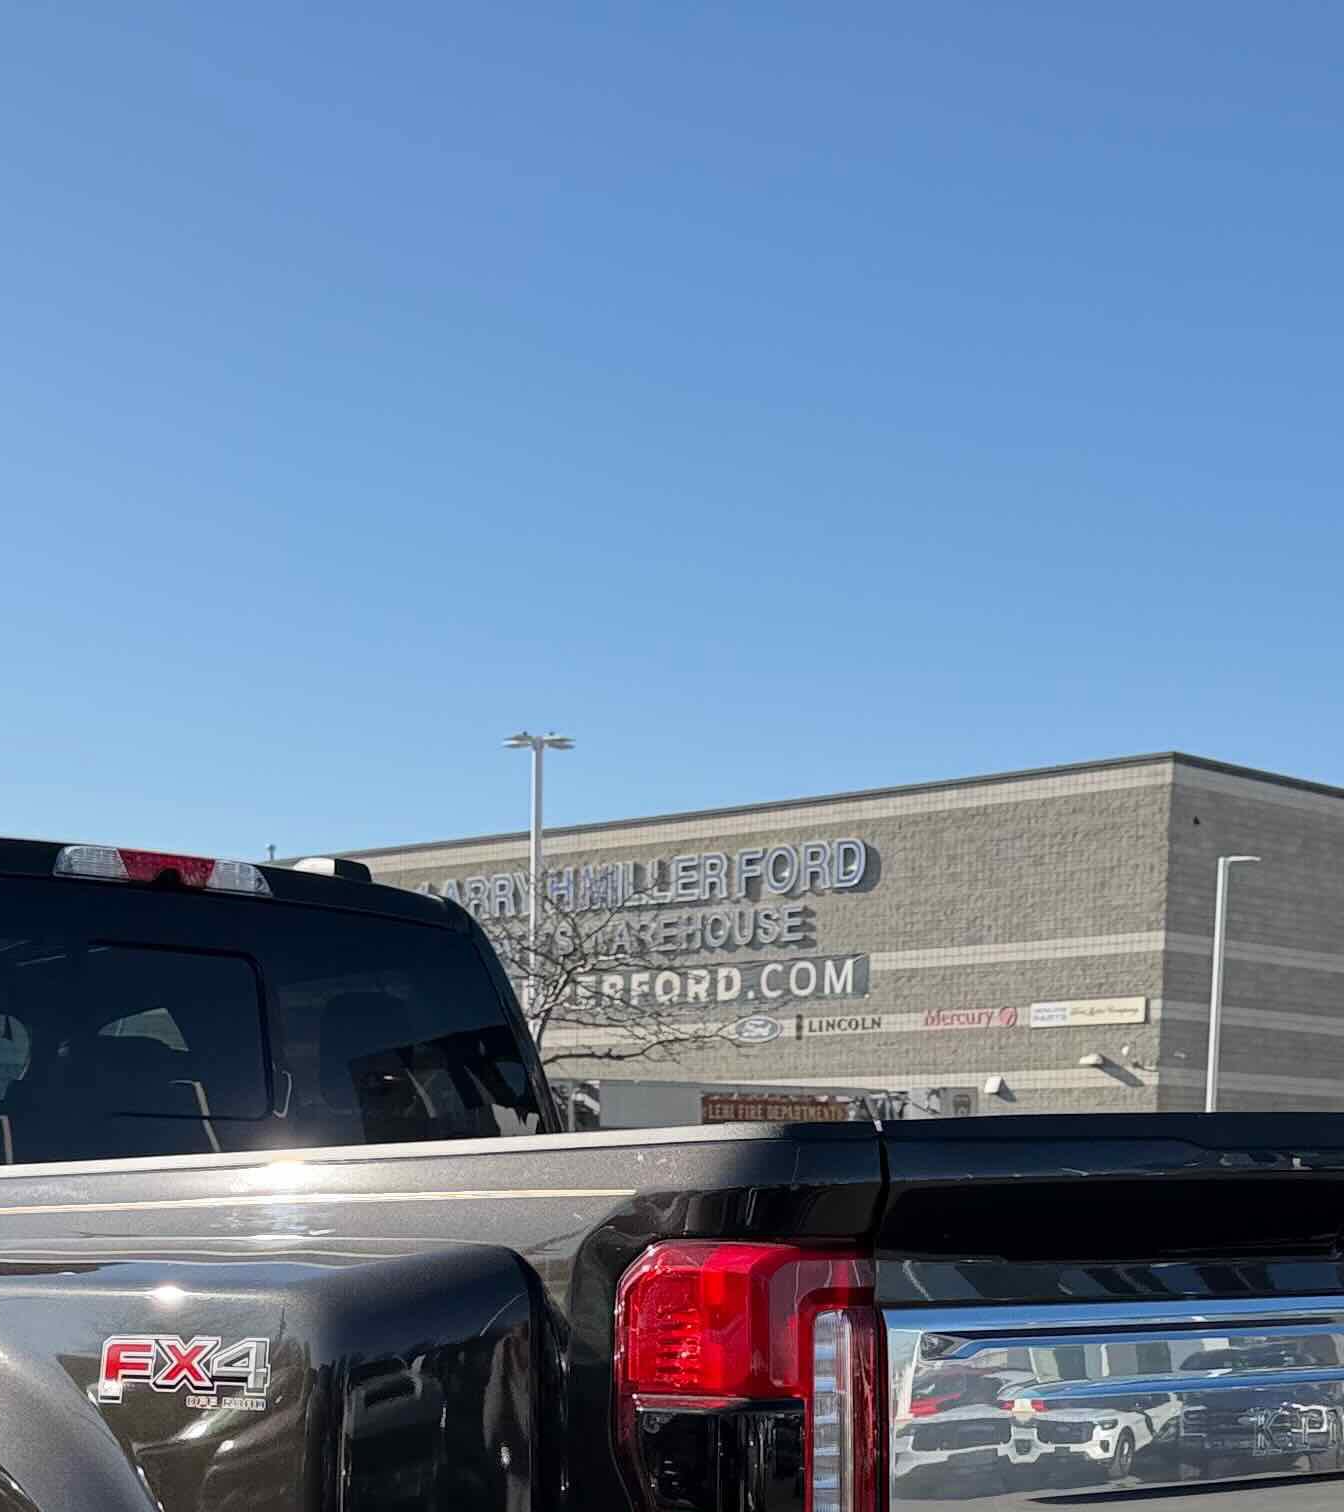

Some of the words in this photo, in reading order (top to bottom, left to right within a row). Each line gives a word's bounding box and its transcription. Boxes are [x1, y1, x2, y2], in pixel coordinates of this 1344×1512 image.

[416, 871, 534, 920] ARRY
[736, 837, 866, 898] FORD
[807, 1016, 882, 1033] LINCOLN
[923, 1008, 994, 1029] Mercury
[98, 1335, 271, 1404] FX4
